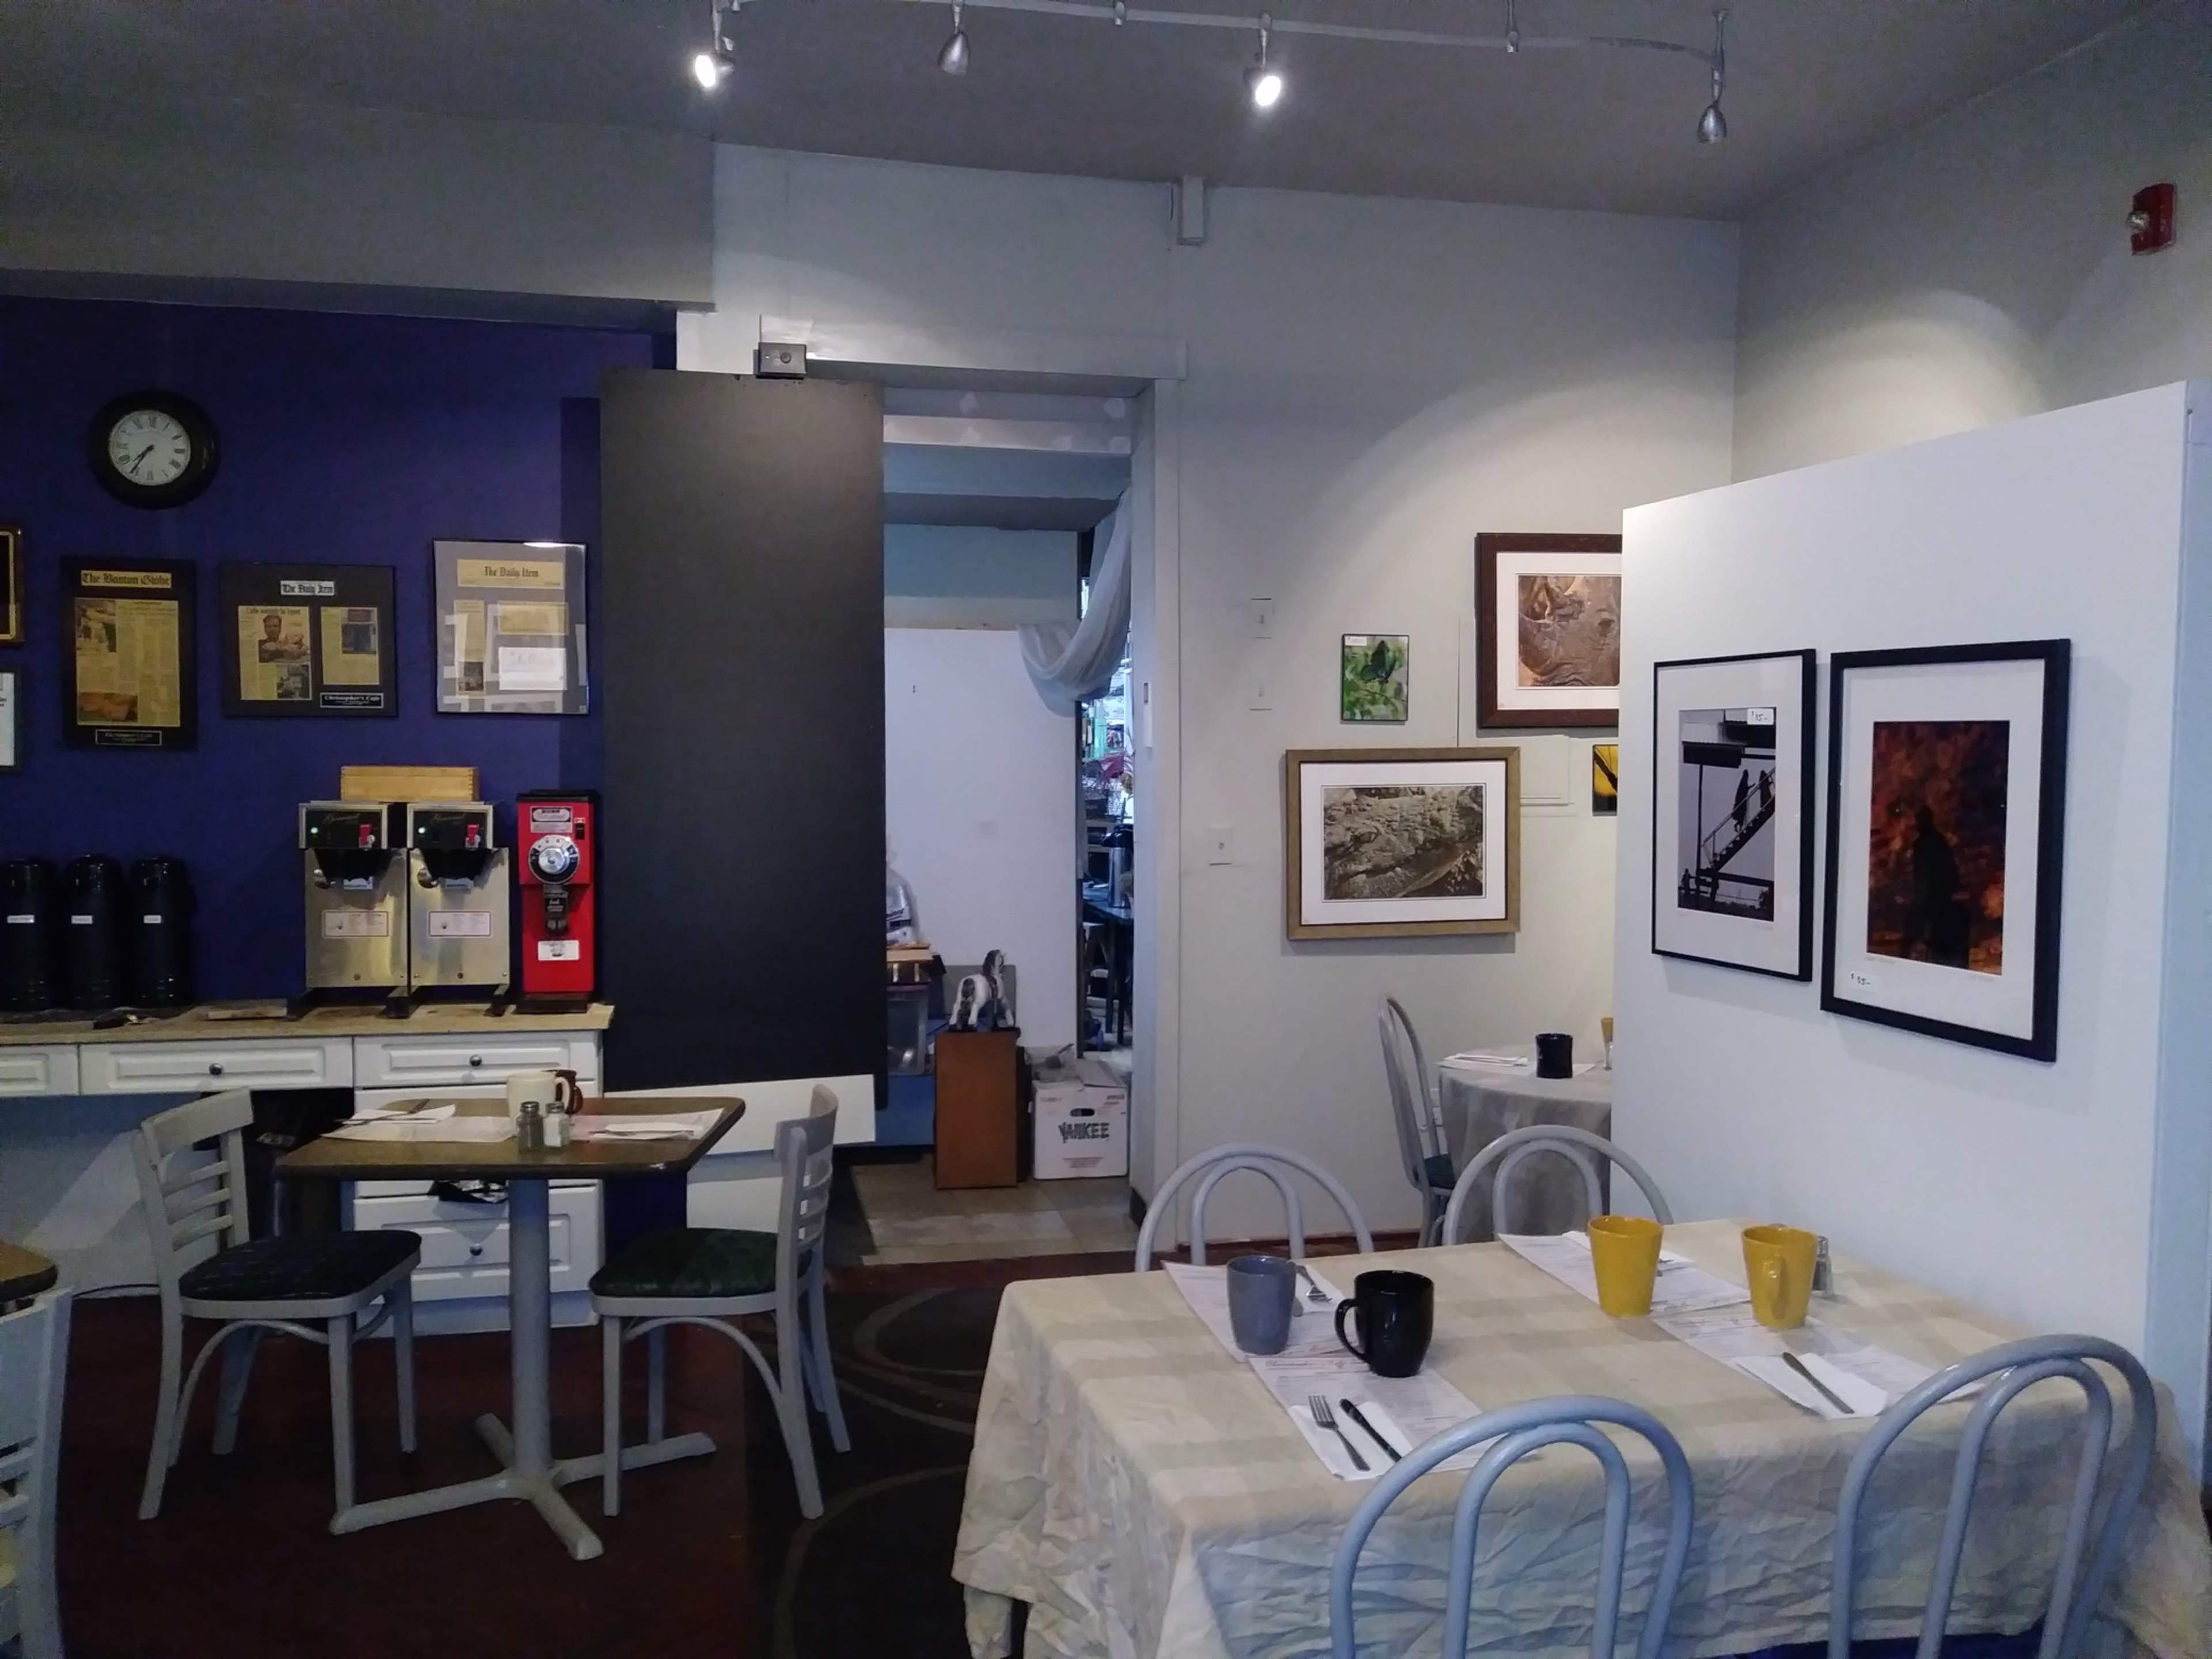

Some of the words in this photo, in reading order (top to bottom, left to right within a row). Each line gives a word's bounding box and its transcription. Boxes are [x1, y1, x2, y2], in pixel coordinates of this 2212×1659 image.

[484, 566, 498, 577] The
[500, 567, 520, 578] Daily
[522, 567, 539, 577] Item
[83, 573, 100, 583] The
[141, 575, 169, 585] Globe
[282, 584, 296, 593] The
[1058, 1122, 1109, 1144] YANKEE
